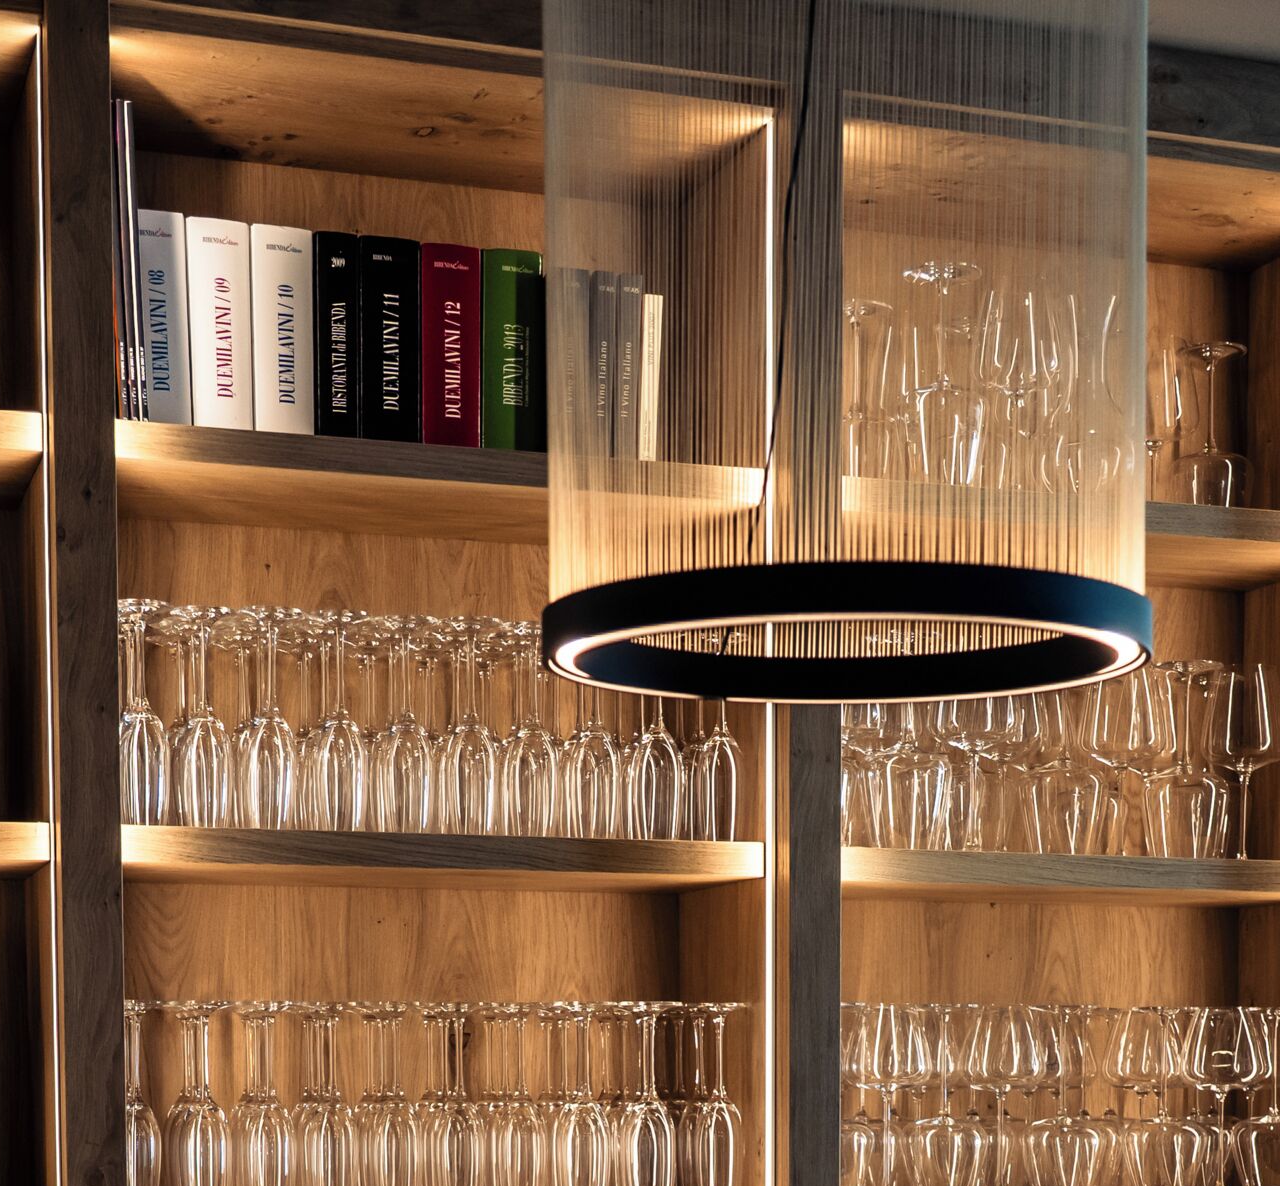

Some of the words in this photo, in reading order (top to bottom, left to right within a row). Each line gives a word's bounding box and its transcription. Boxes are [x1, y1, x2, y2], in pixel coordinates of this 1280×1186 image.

[148, 269, 165, 286] 08
[331, 256, 346, 268] 2009
[214, 277, 231, 293] 09
[277, 284, 294, 298] 10
[382, 293, 400, 307] 11
[331, 302, 347, 342] BIBENDA
[444, 301, 461, 316] 12
[148, 299, 171, 392] DUEMILAVINI
[215, 306, 234, 398] DUEMILAVINI
[503, 323, 525, 350] 2013
[278, 313, 296, 405] DUEMILAVINI
[382, 320, 400, 411] DUEMILAVINI
[444, 329, 462, 419] DUEMILAVINI
[598, 340, 608, 379] Italiano
[622, 341, 632, 380] Italiano
[331, 352, 348, 407] RISTORANTI
[502, 357, 524, 406] BIBENDA
[598, 382, 607, 407] Vino
[621, 382, 631, 407] Vino
